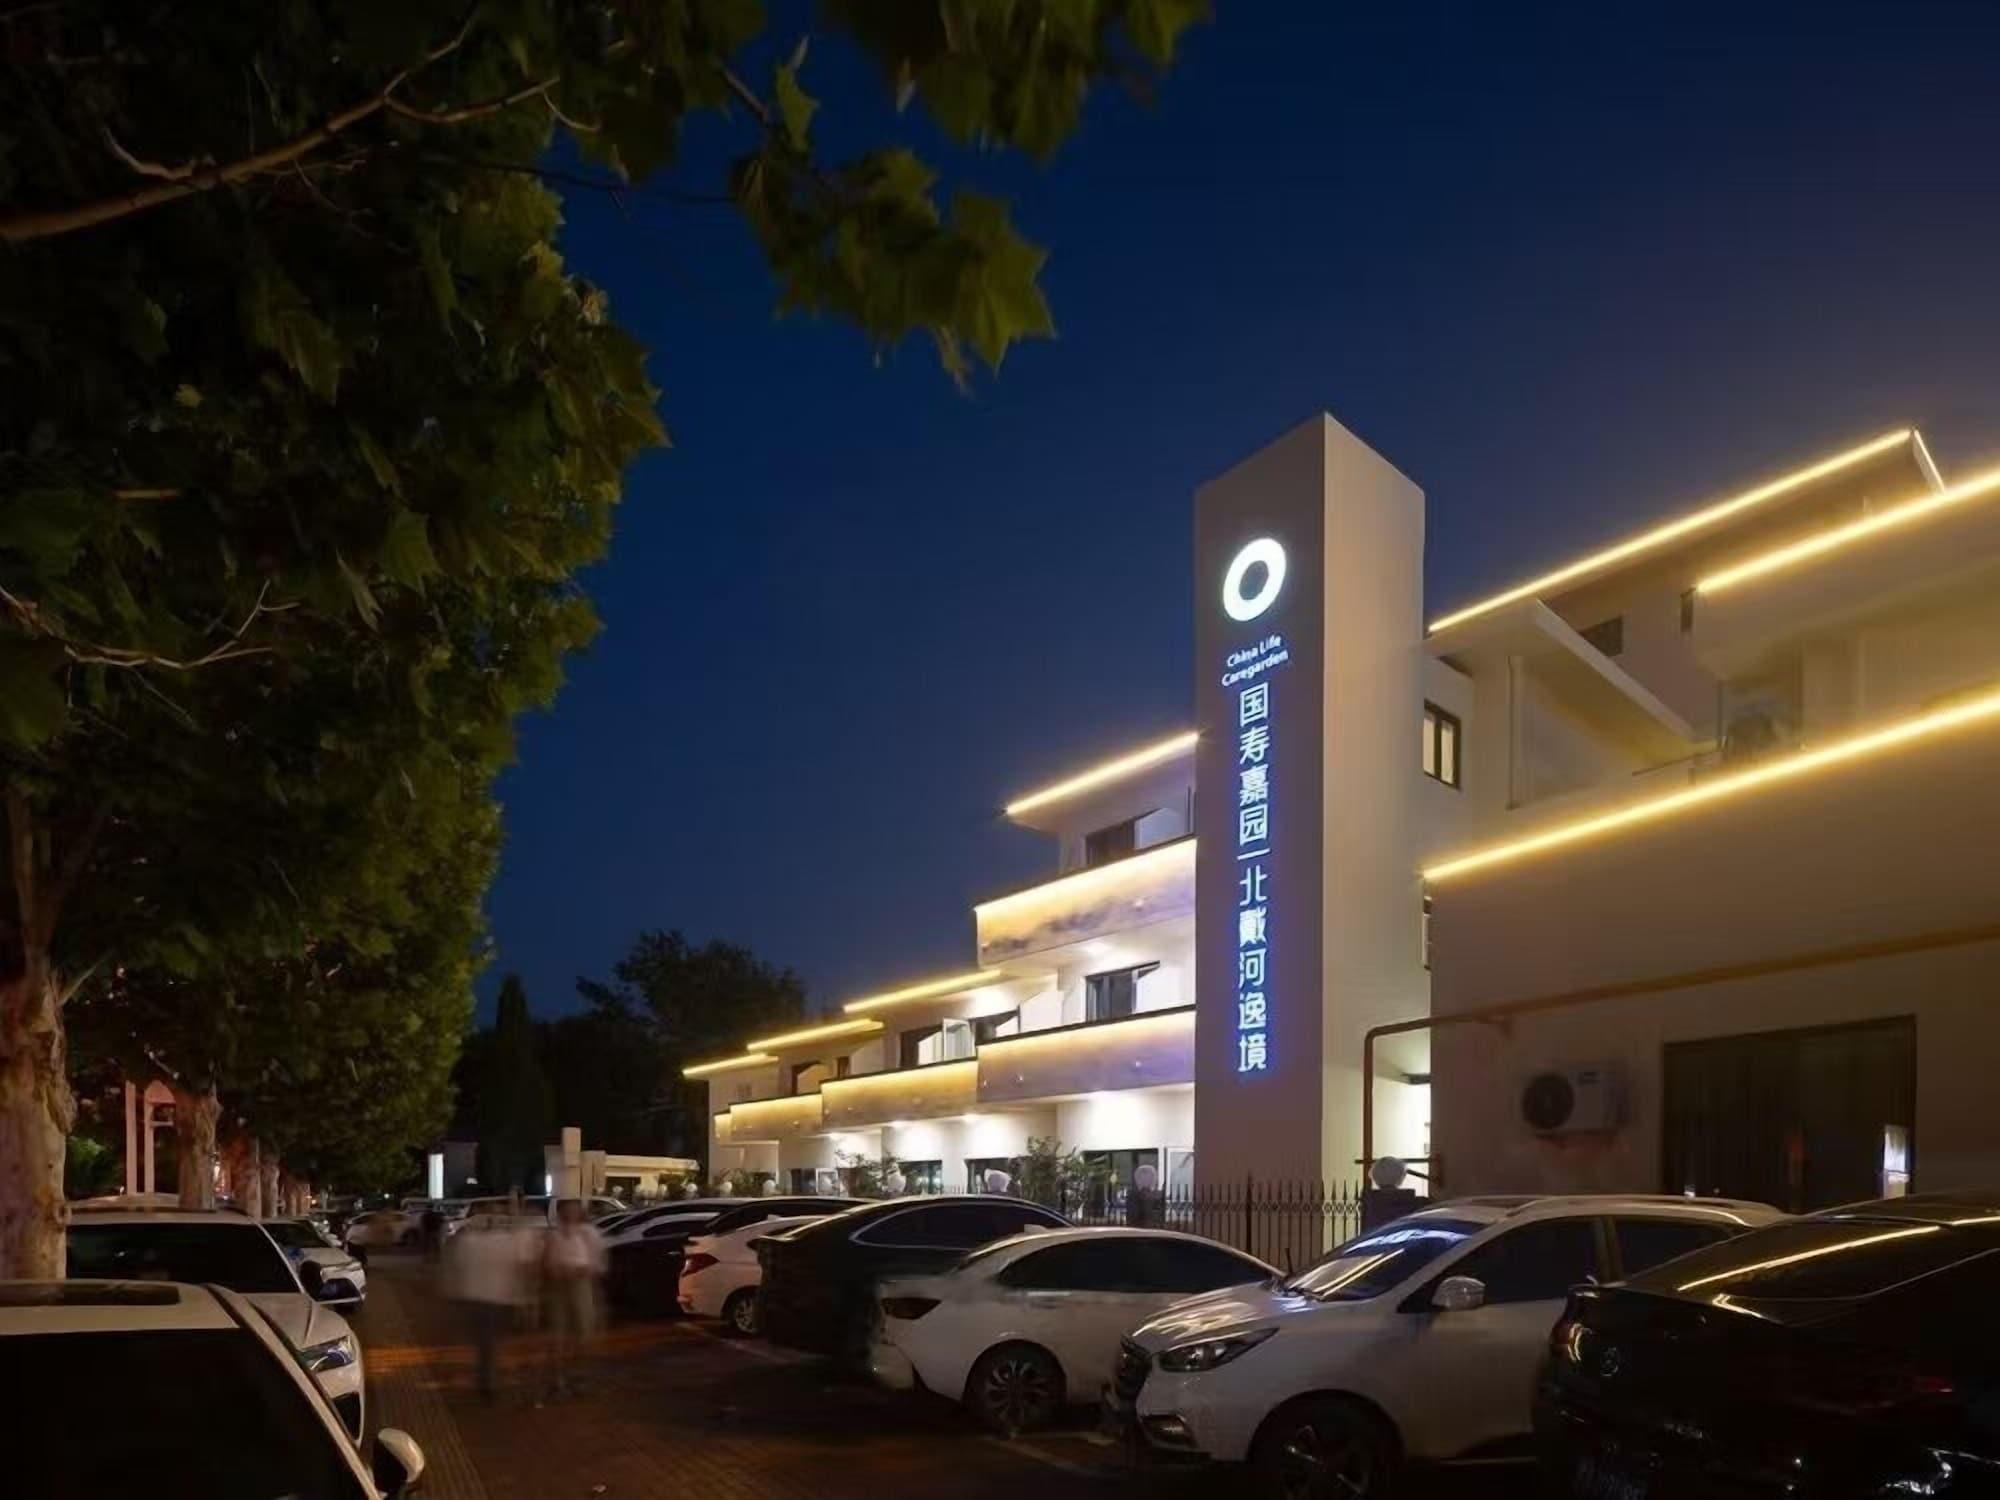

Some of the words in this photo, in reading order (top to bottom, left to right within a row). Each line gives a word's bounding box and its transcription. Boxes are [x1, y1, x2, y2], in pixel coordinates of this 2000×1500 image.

[1226, 647, 1259, 667] China
[1260, 634, 1282, 654] Life
[1221, 650, 1289, 686] Caregarden
